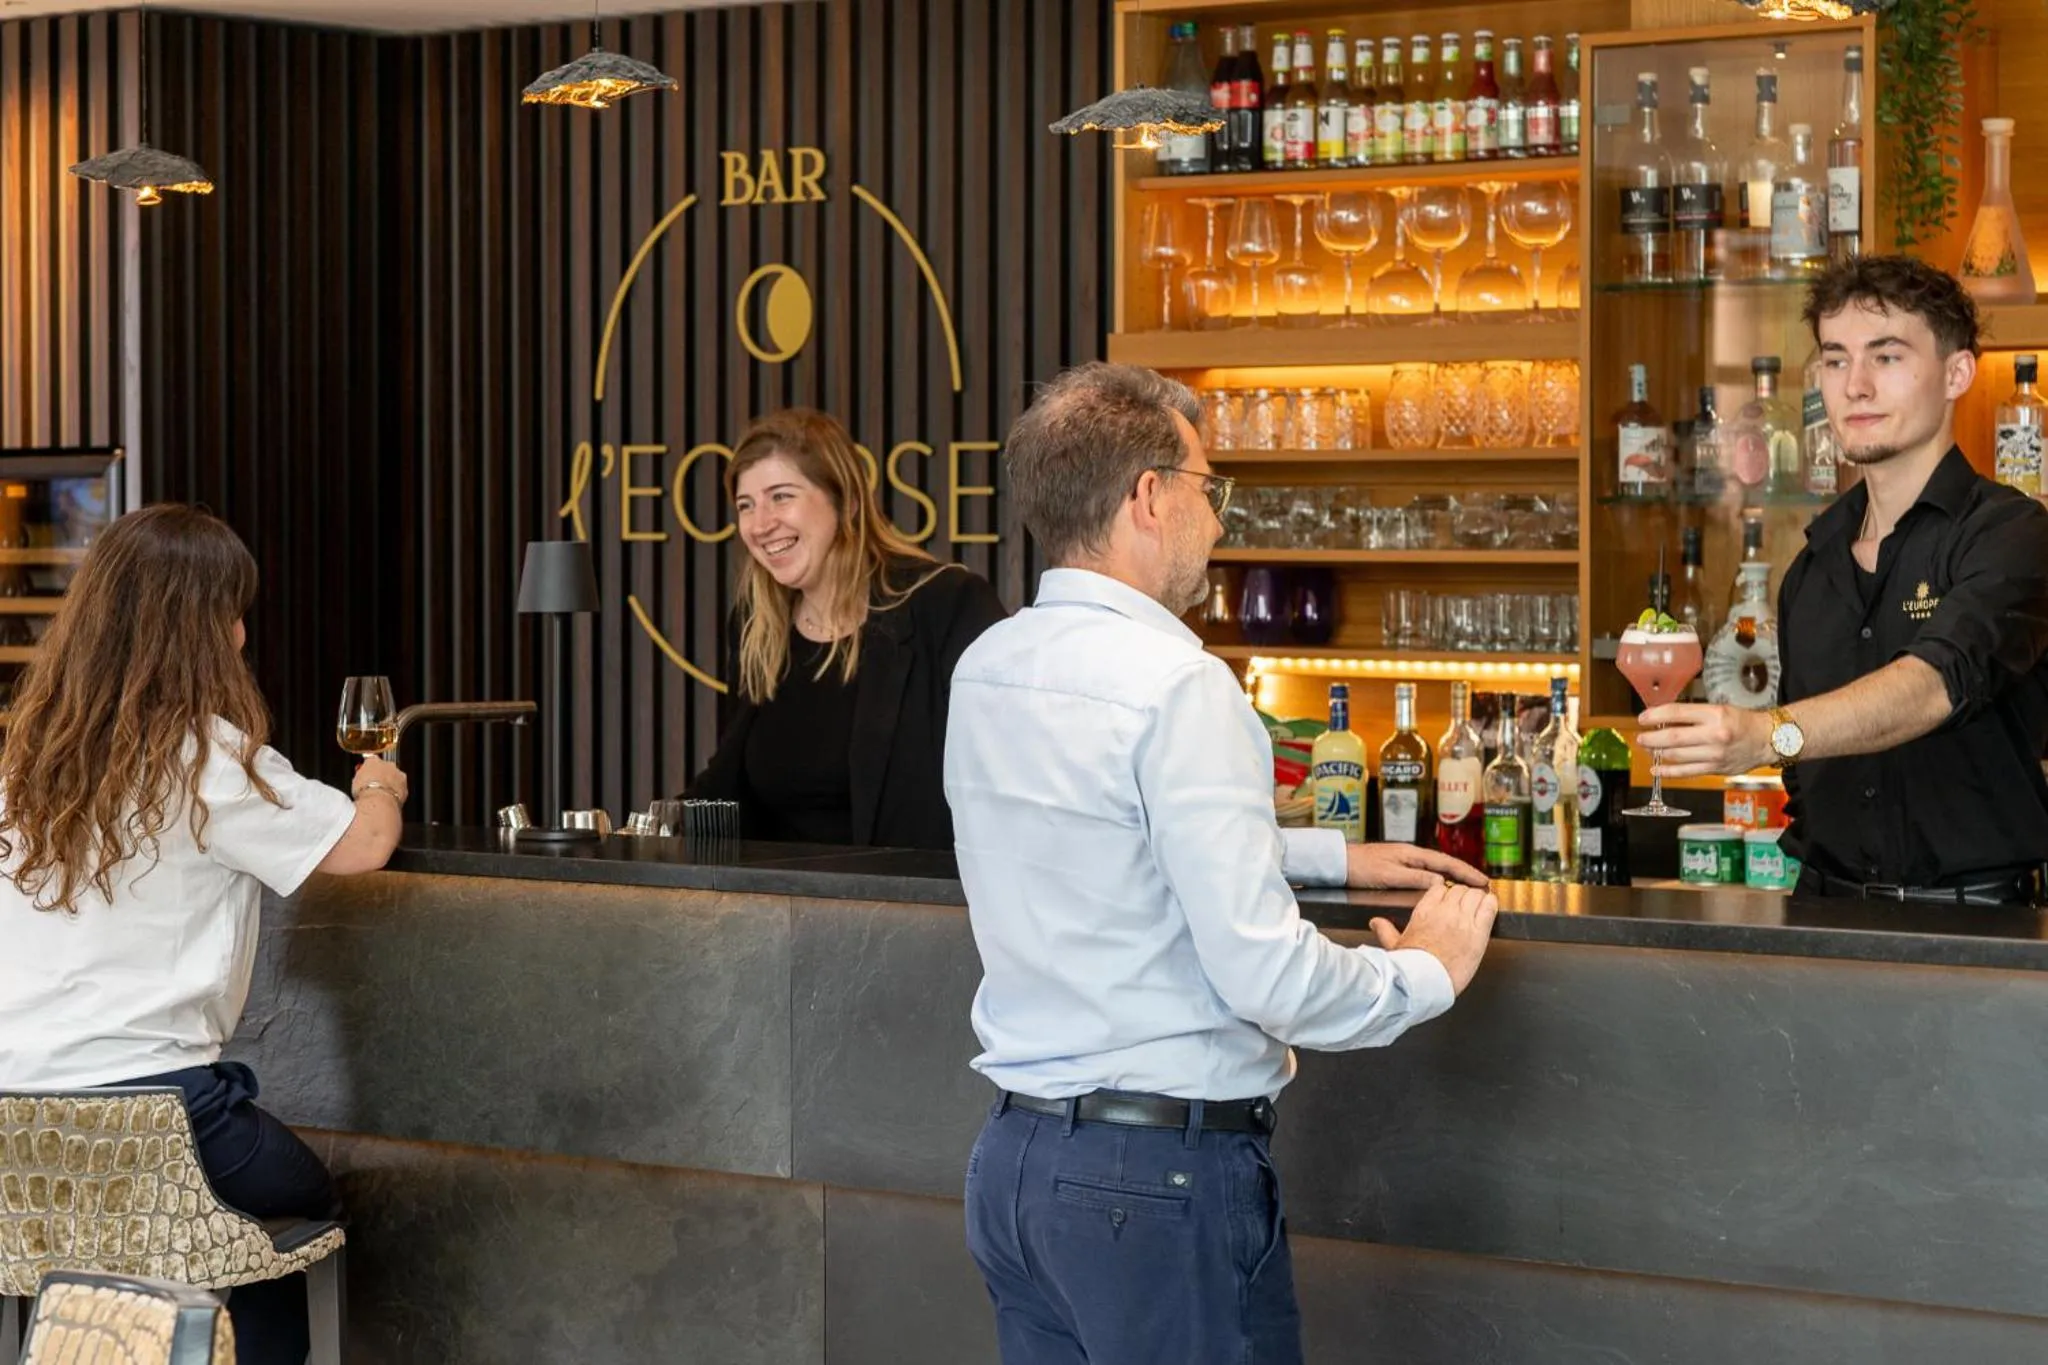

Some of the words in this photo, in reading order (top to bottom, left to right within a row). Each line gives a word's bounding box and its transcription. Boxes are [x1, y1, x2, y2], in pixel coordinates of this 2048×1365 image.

[720, 147, 828, 206] BAR
[559, 440, 1001, 544] l'ECSE
[1315, 761, 1361, 779] PACIFIC
